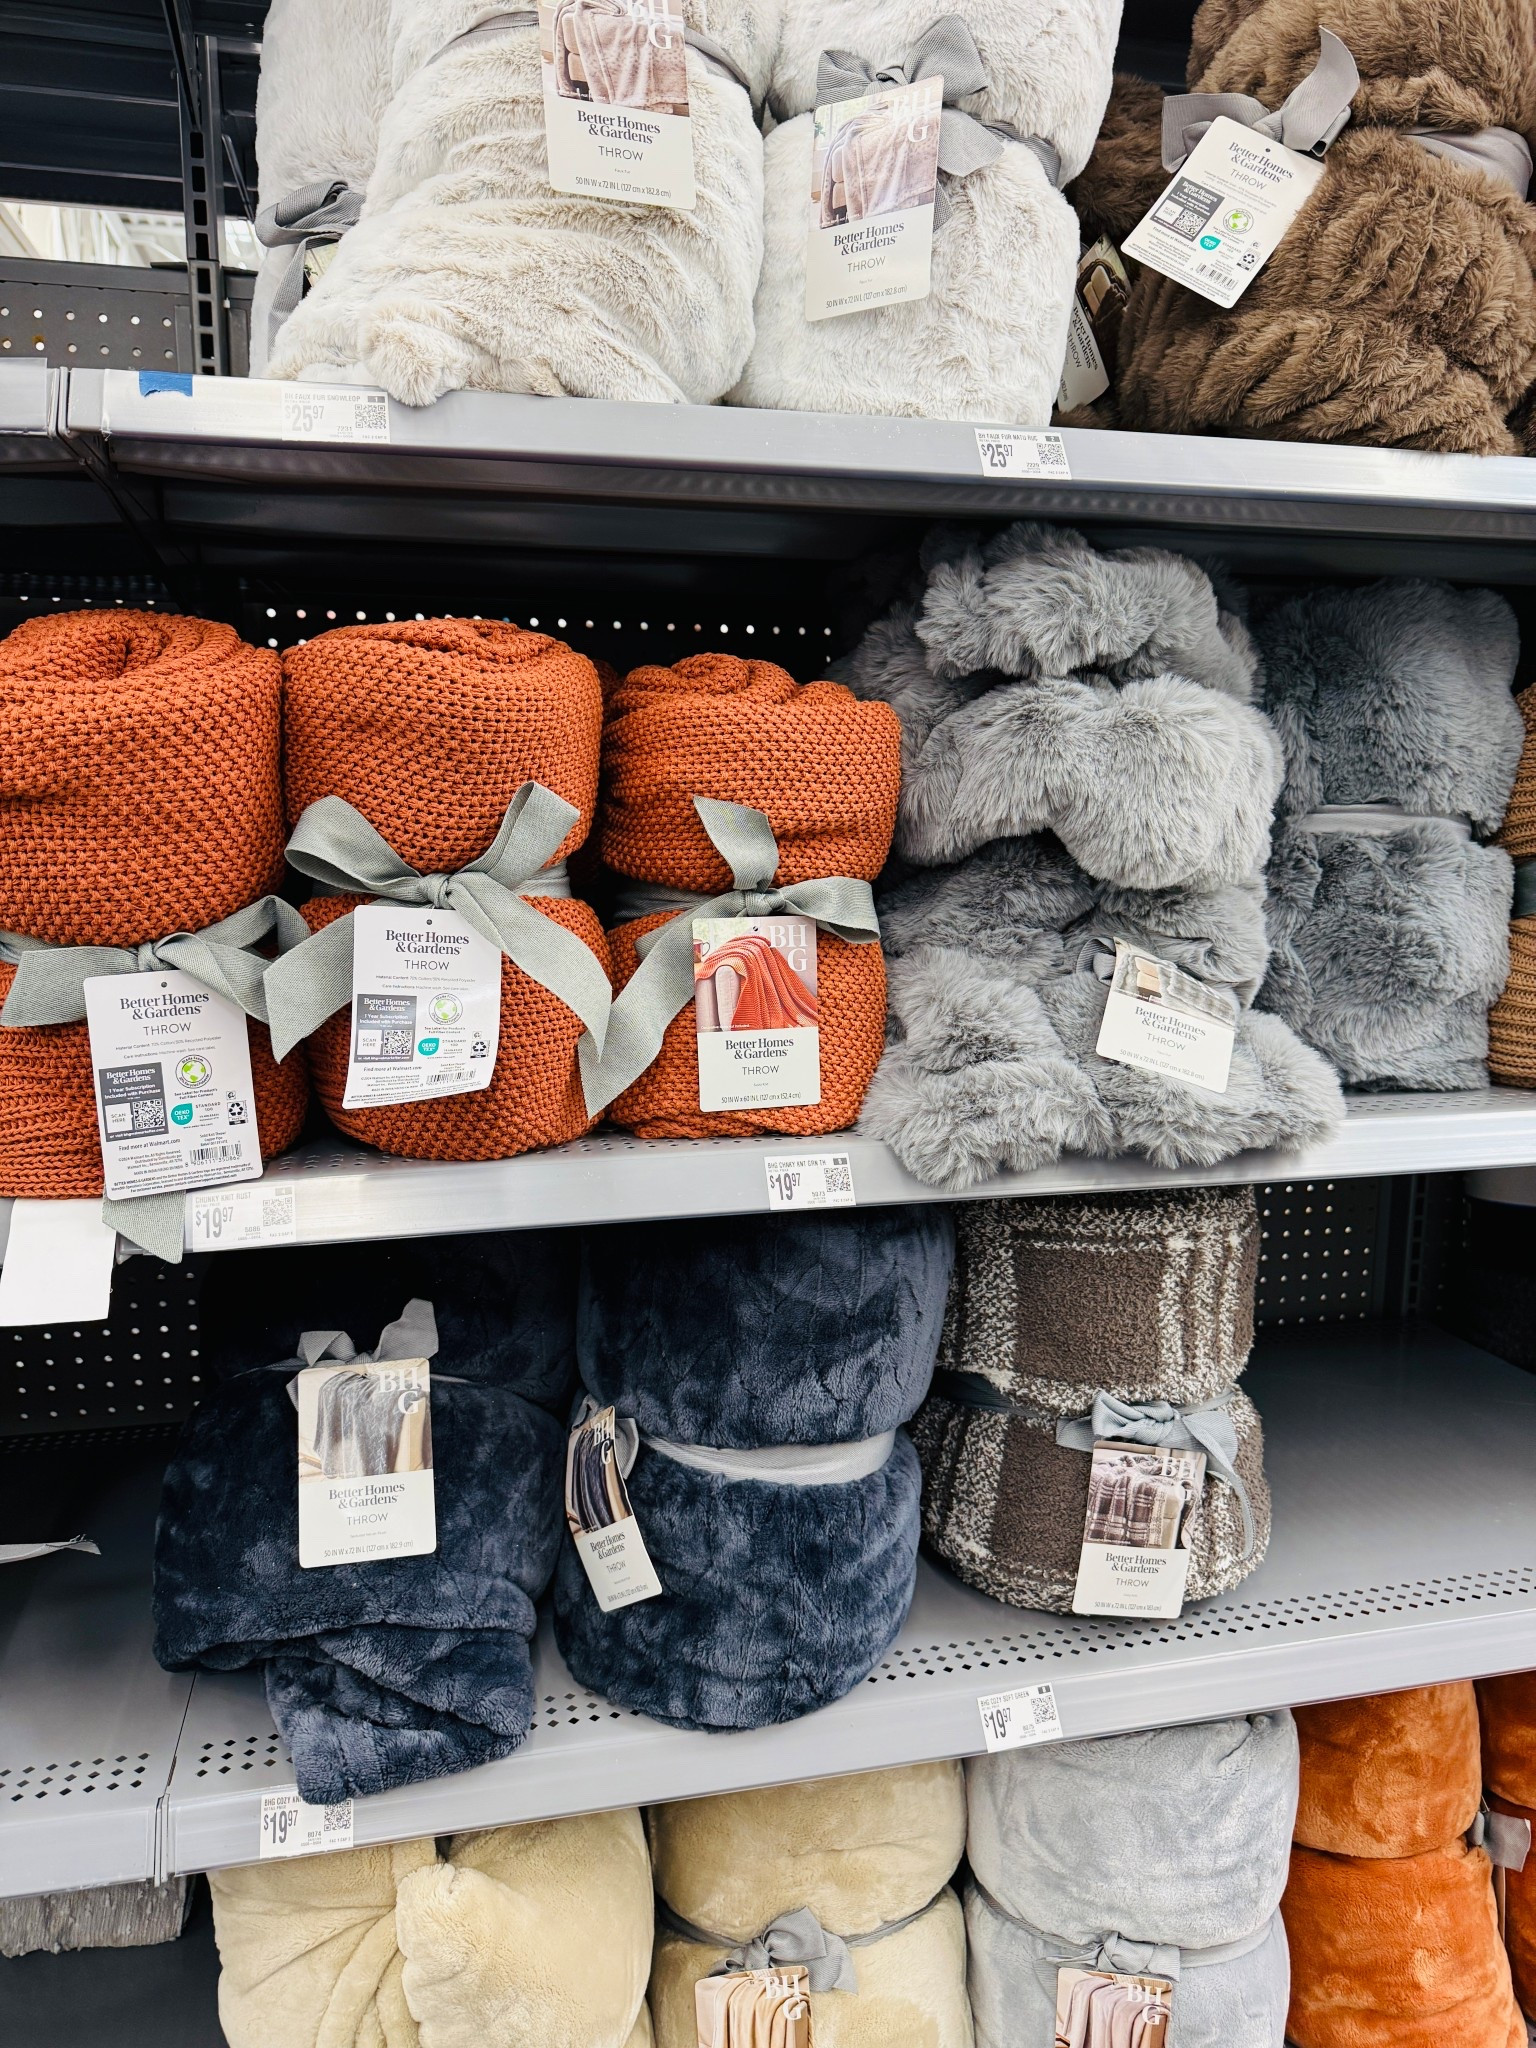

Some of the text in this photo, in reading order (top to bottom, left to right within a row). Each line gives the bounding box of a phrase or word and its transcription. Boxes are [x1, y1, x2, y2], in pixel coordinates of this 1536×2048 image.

[648, 22, 673, 49] G
[577, 110, 660, 134] Better Homes
[908, 114, 929, 142] G
[598, 146, 643, 161] THROW
[1229, 142, 1294, 179] Better Homes
[1230, 169, 1268, 190] THROW
[834, 222, 904, 246] Better Homes
[848, 256, 886, 272] THROW
[1068, 334, 1082, 368] THROW
[1084, 334, 1098, 370] Homes
[386, 930, 469, 944] Better Homes
[768, 925, 808, 948] BH
[404, 960, 450, 970] THROW
[788, 948, 808, 972] G
[120, 993, 209, 1010] Better Homes
[364, 998, 385, 1006] Better
[143, 1022, 192, 1036] THROW
[1135, 1006, 1206, 1036] Better Homes
[725, 1038, 794, 1050] Better Homes
[1146, 1033, 1186, 1050] THROW
[107, 1071, 129, 1079] Better
[742, 1065, 779, 1075] THROW
[149, 1139, 180, 1147] Walmart.com
[196, 1195, 219, 1204] CHUNKY
[236, 1192, 251, 1200] RUST
[379, 1367, 422, 1392] BH
[398, 1391, 419, 1414] G
[594, 1416, 610, 1446] BH
[601, 1440, 612, 1465] G
[329, 1483, 405, 1500] Better Homes
[347, 1512, 388, 1526] THROW
[590, 1532, 625, 1552] Better Homes
[606, 1561, 626, 1573] THROW
[1106, 1553, 1167, 1565] Better Homes
[1116, 1578, 1149, 1587] THROW
[265, 1798, 275, 1806] BHG
[765, 1974, 800, 1999] BH
[1128, 1983, 1164, 2006] BH
[783, 1997, 802, 2020] G
[1142, 2005, 1162, 2026] G
